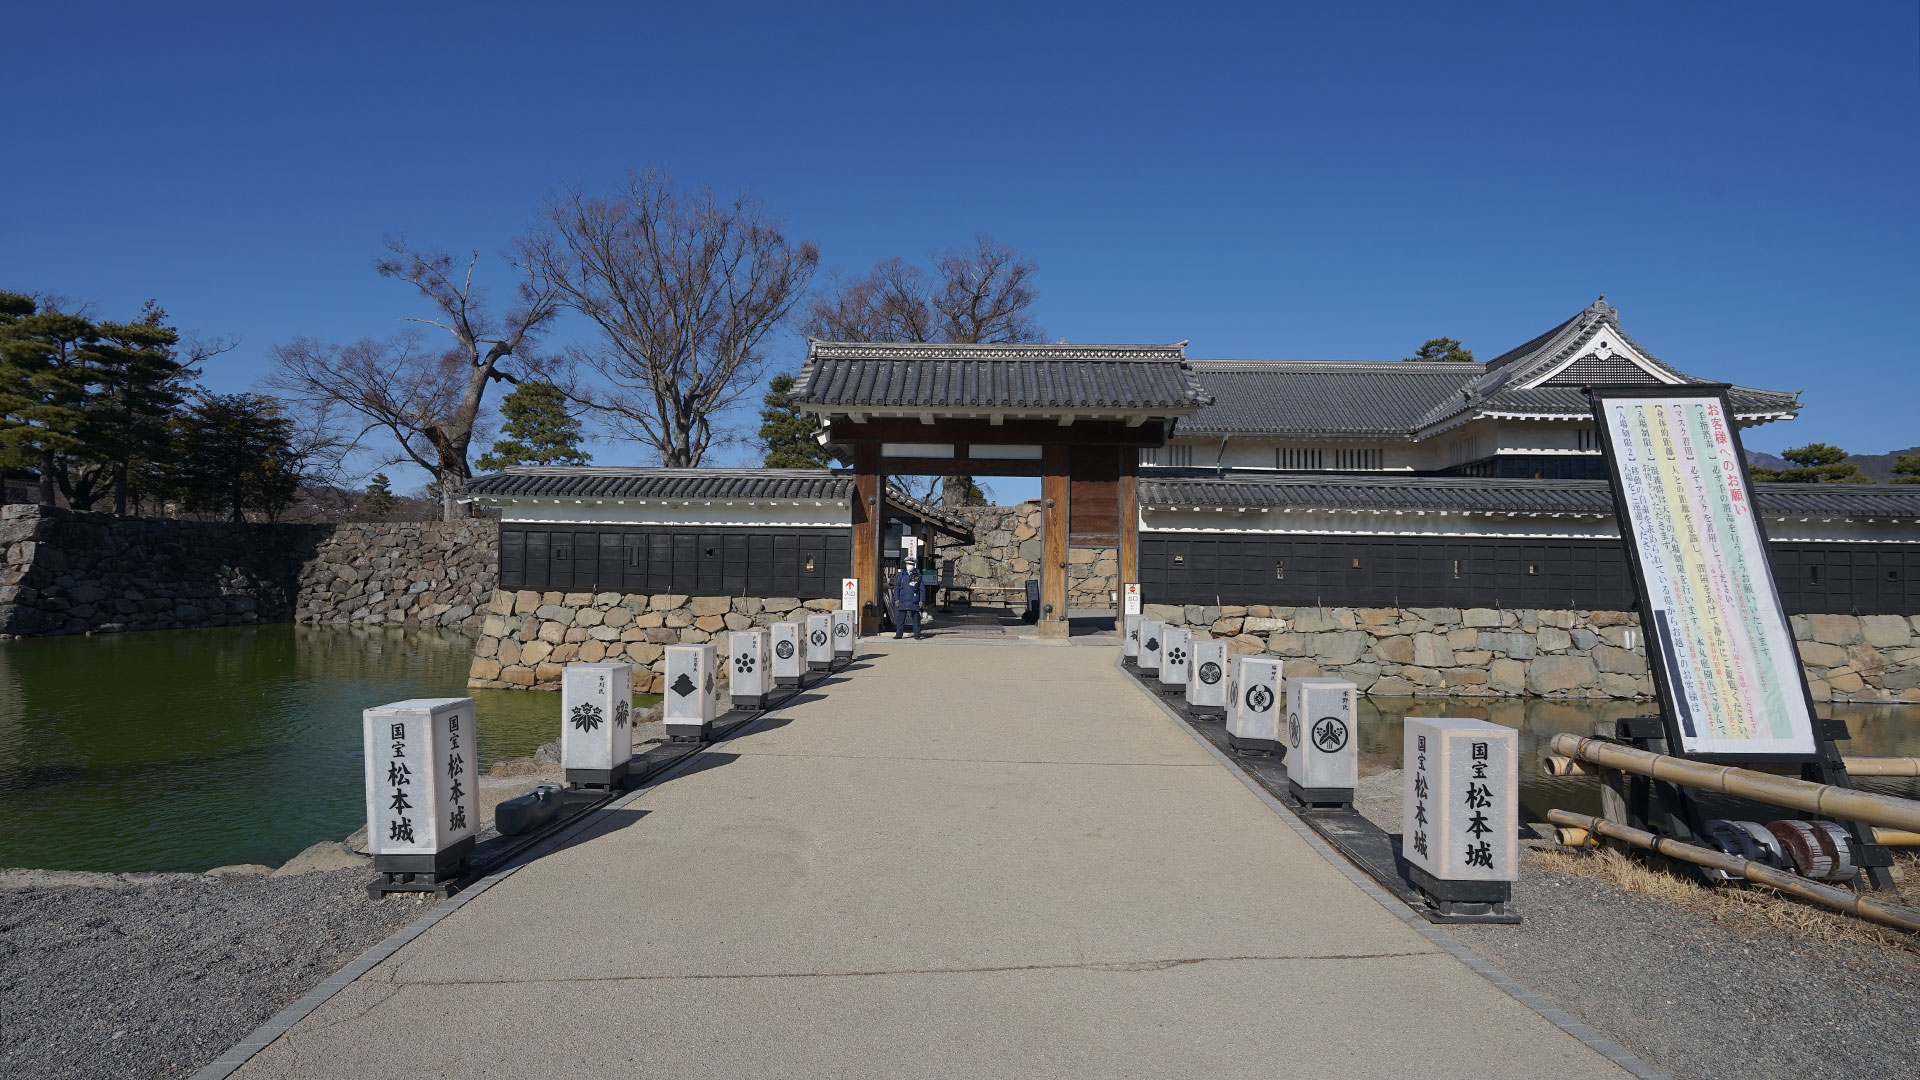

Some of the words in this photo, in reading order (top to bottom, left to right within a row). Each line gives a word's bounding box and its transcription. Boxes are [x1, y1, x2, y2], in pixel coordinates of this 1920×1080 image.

[1705, 403, 1748, 515] お客様へのお願い
